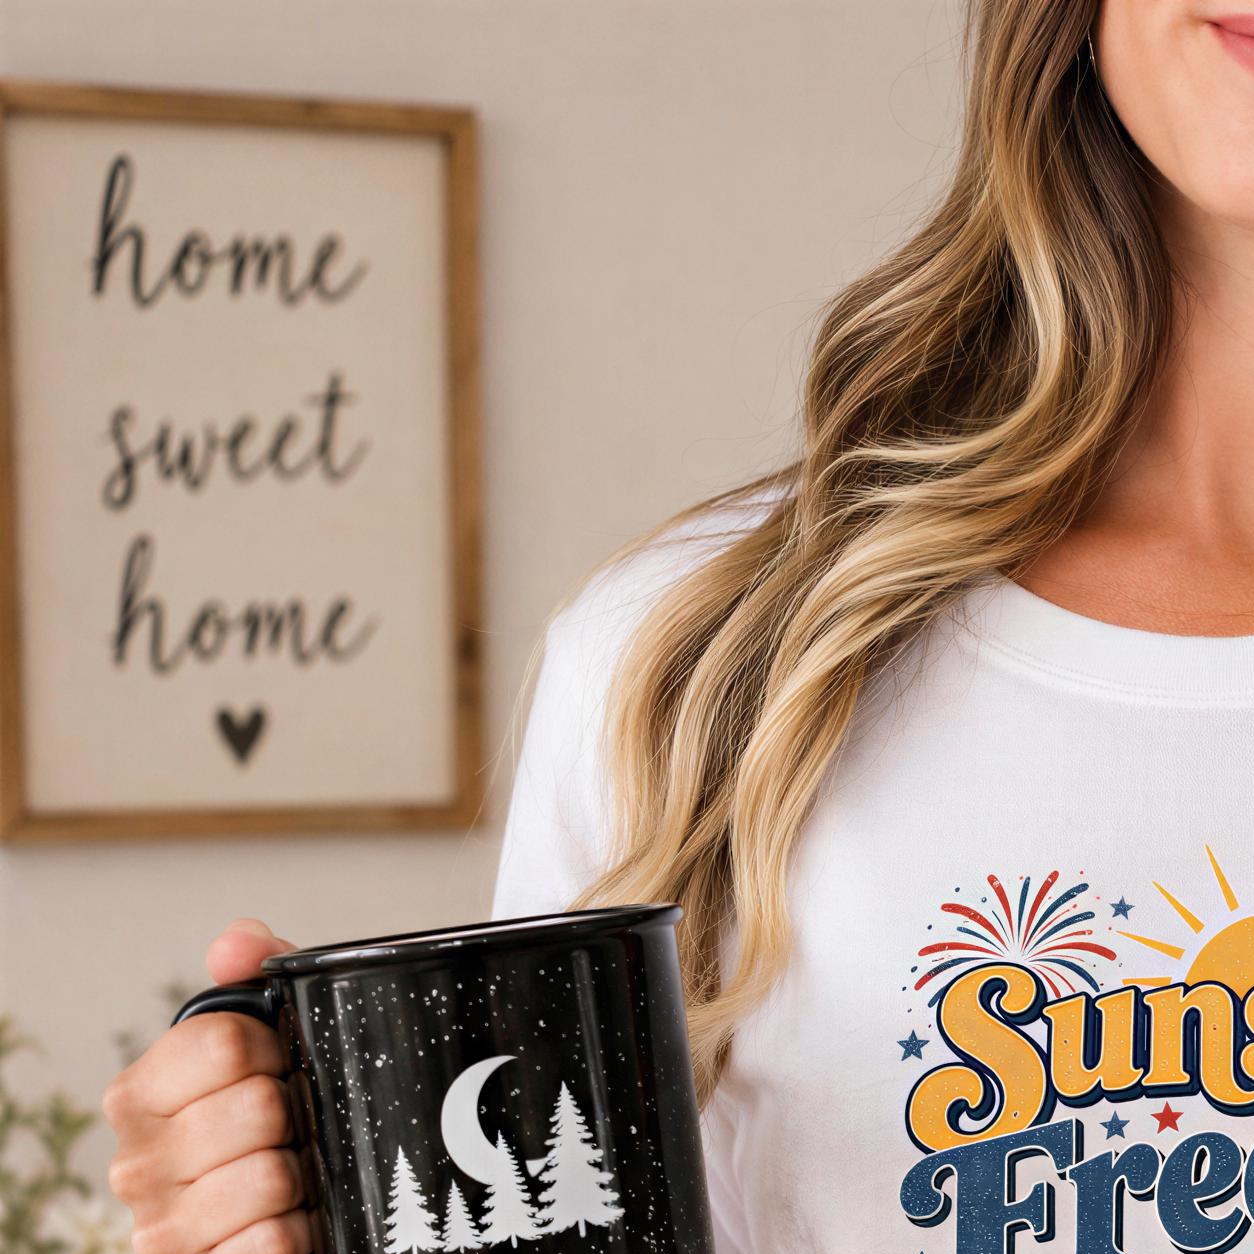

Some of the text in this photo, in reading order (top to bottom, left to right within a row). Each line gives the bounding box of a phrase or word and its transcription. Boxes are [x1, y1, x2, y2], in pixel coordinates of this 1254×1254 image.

[90, 152, 370, 308] home
[101, 370, 371, 510] sweet
[110, 532, 380, 675] home
